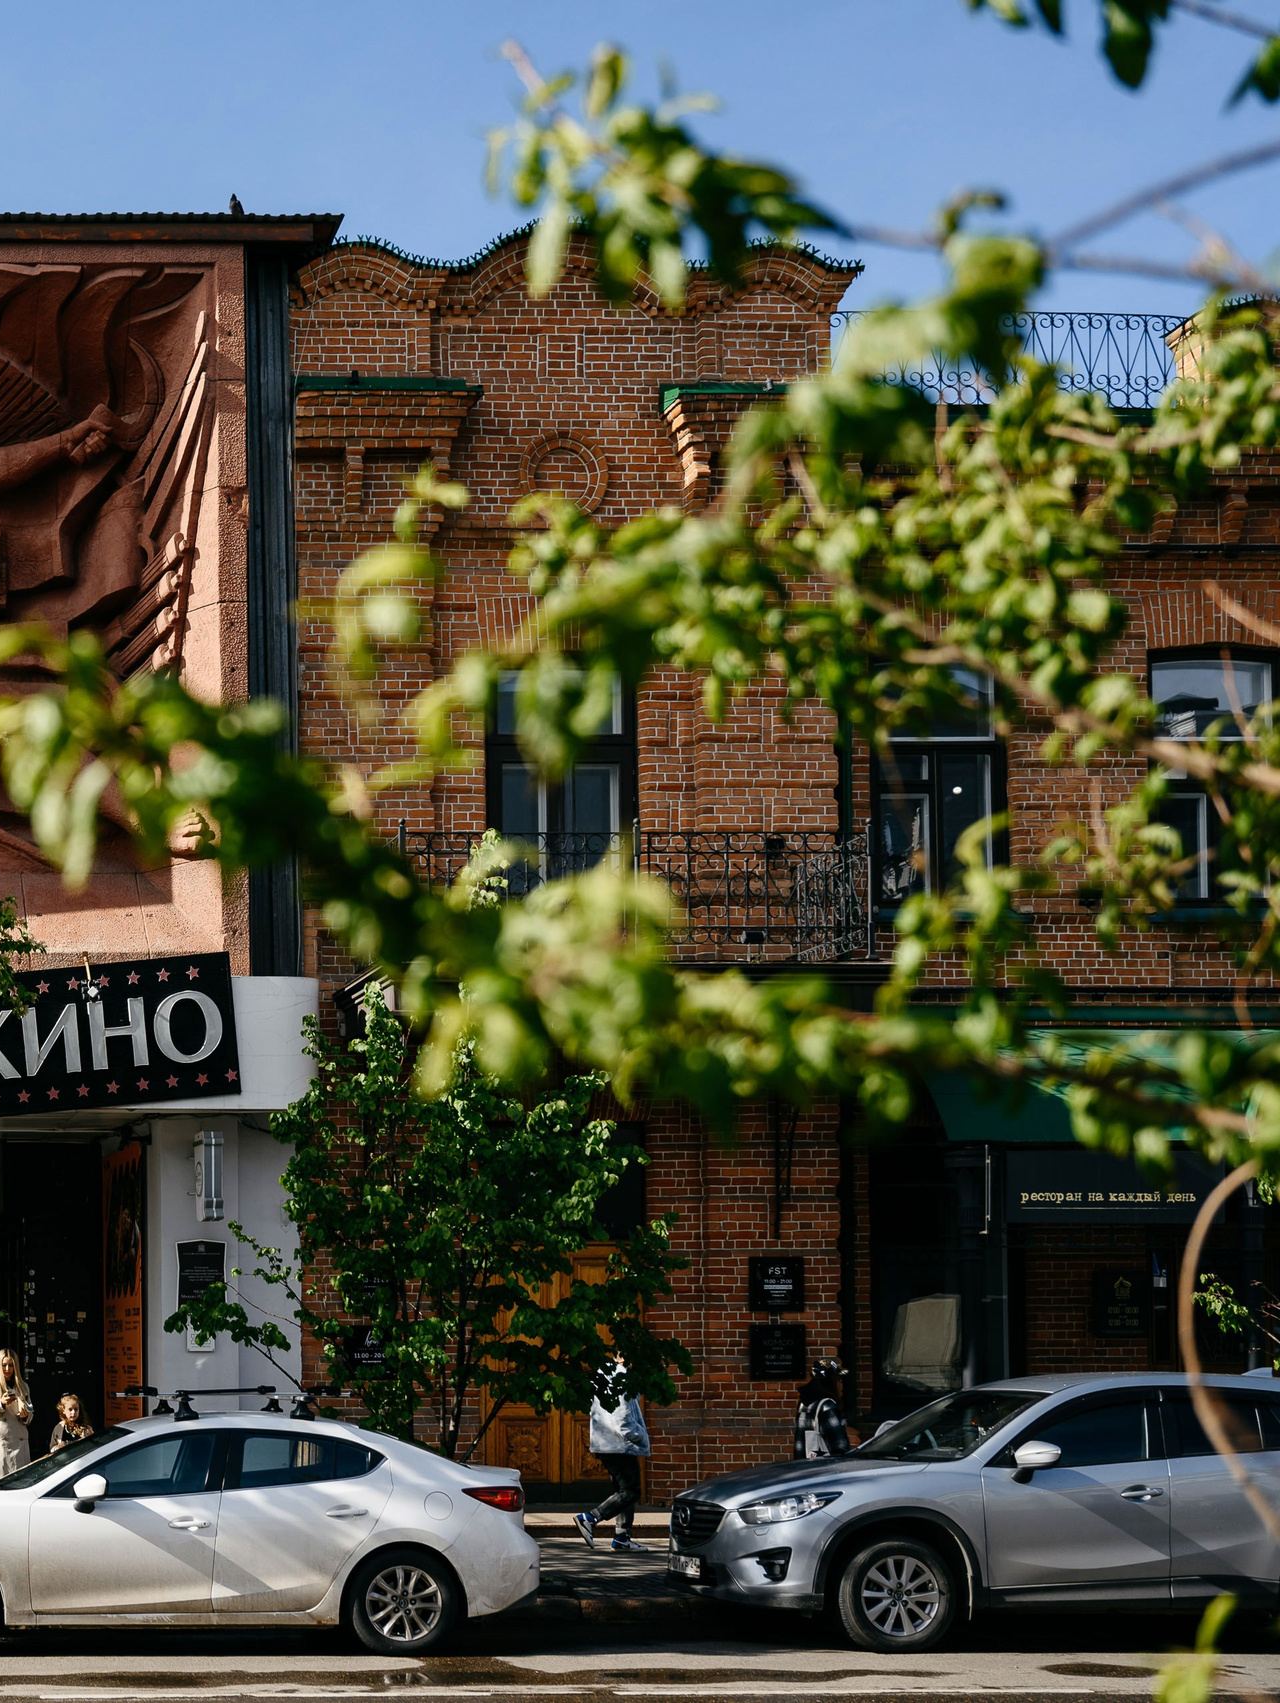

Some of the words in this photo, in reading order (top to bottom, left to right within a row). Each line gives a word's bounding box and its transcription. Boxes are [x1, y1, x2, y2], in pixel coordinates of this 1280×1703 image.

[1020, 1191, 1082, 1204] ресторан
[1088, 1192, 1105, 1201] на
[1108, 1191, 1161, 1203] каждый
[1166, 1192, 1197, 1203] день
